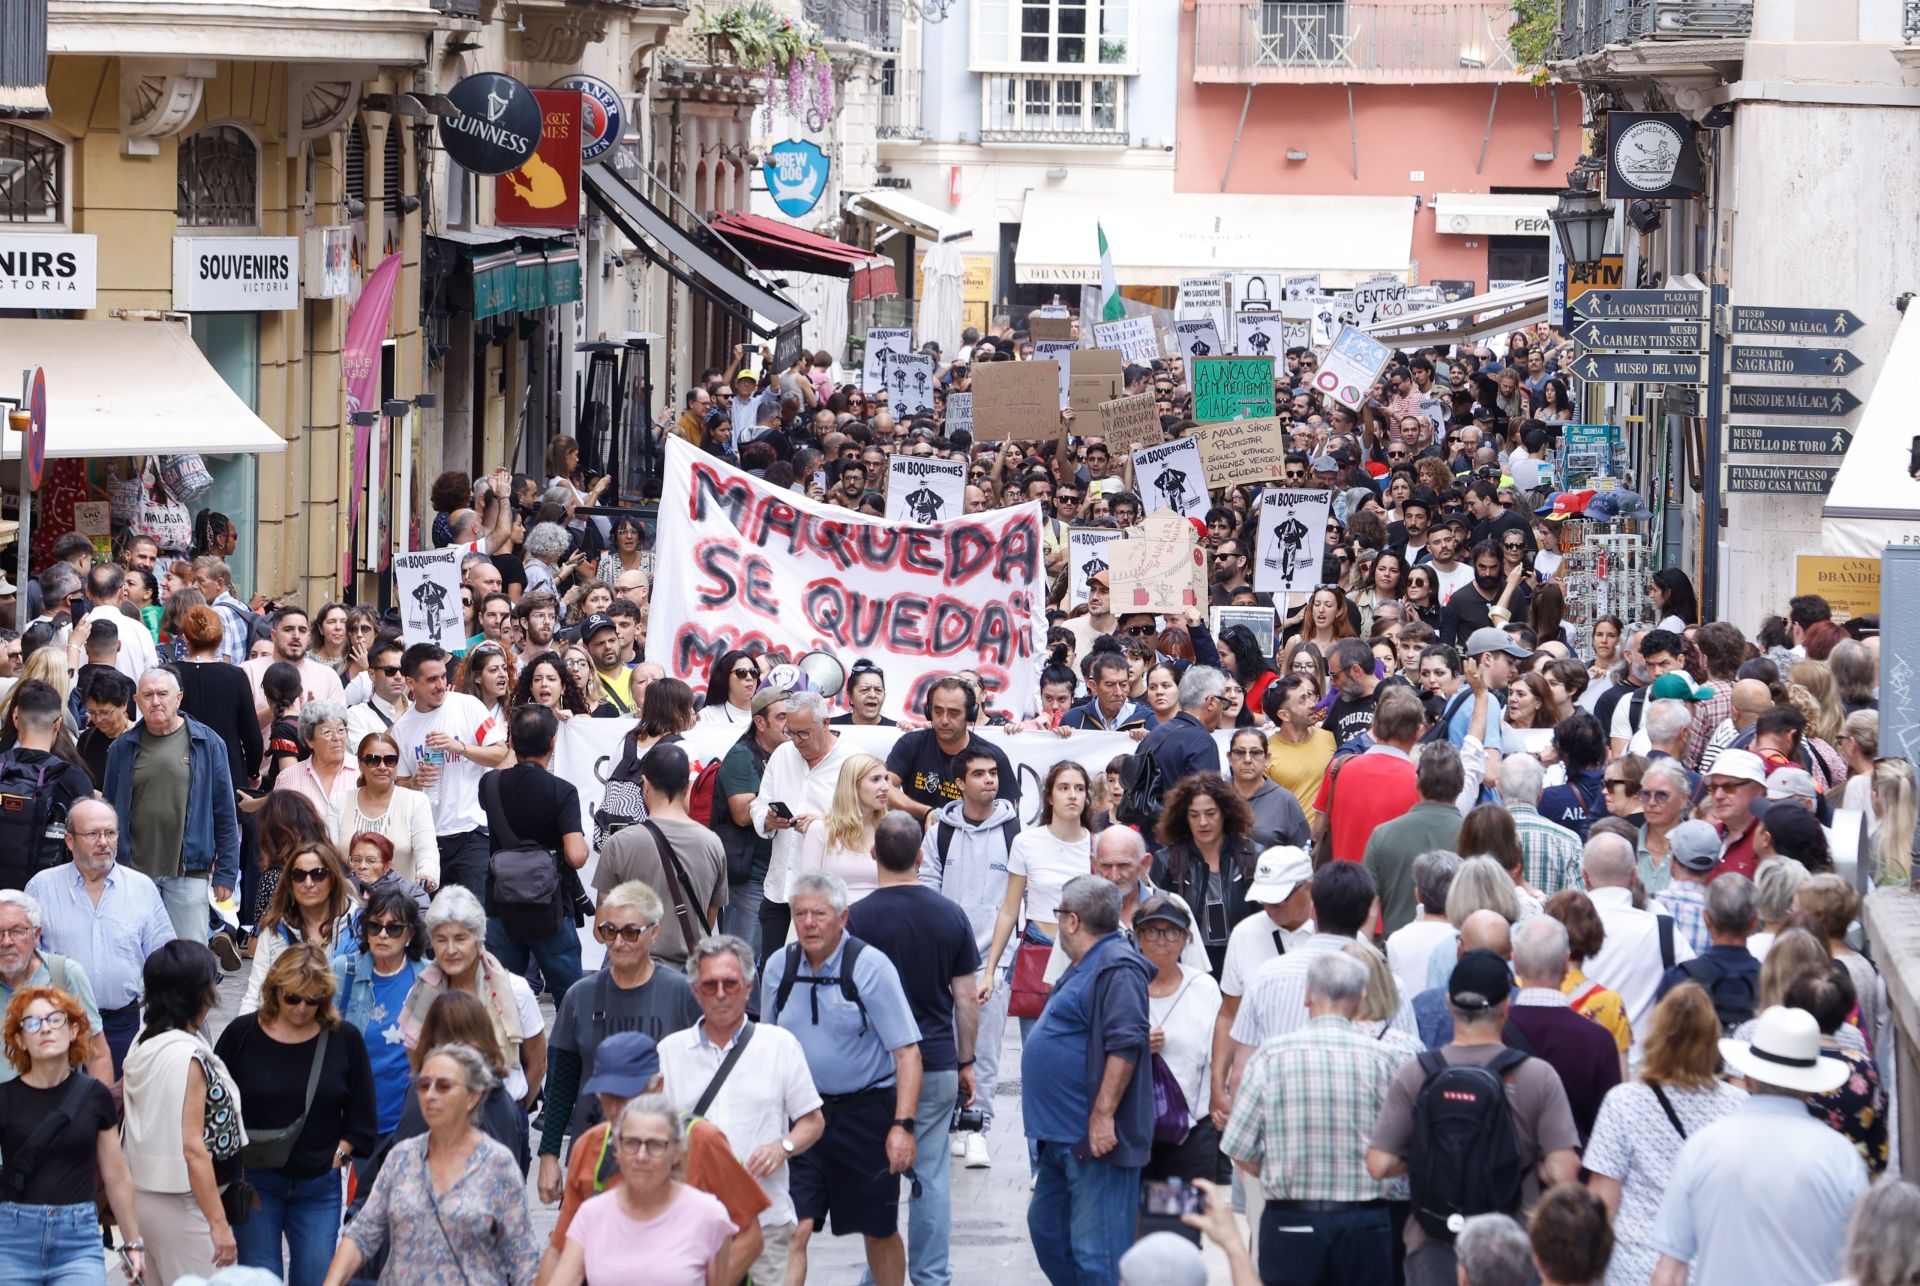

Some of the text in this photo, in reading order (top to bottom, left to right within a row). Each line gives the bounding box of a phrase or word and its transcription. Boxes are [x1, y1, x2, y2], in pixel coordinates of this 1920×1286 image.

[1631, 126, 1667, 139] MONEDAS
[775, 152, 806, 167] BREW
[780, 167, 802, 181] DOG
[200, 254, 289, 280] SOUVENIRS
[1571, 265, 1623, 284] ATM
[243, 282, 289, 292] VICTORIA
[1664, 294, 1698, 302] PLAZA DE
[1608, 301, 1697, 316] LA CONSTITUCIÓN
[1738, 309, 1765, 319] MUSEO
[1239, 314, 1280, 325] SIN BOQUERONES
[1738, 318, 1828, 334] PICASSO MÁLAGA
[869, 330, 910, 340] SIN BOQUERONES
[1185, 321, 1214, 334] BOQUERONES
[1670, 326, 1697, 335] MUSEO
[1044, 342, 1075, 353] BOQUERONES
[1603, 335, 1697, 347] CARMEN THYSSEN
[889, 354, 930, 365] SIN BOQUERONES
[1738, 348, 1785, 359] IGLESIA DEL
[1195, 361, 1209, 381] LA
[1246, 362, 1272, 381] CASA
[1615, 363, 1697, 375] MUSEO DEL VINO
[1736, 359, 1795, 373] SAGRARIO
[1194, 380, 1210, 396] QUE
[1732, 393, 1829, 409] MUSEO DE MÁLAGA
[1144, 423, 1154, 434] EN
[1191, 422, 1274, 441] DE NADA SIRVE
[1733, 428, 1763, 438] MUSEO
[1135, 437, 1196, 466] SIN BOQUERONES
[1211, 436, 1264, 452] PROTESTAR
[1733, 439, 1827, 453] REVELLO DE TORO
[1207, 447, 1275, 464] SIGUES VOTANDO
[892, 461, 963, 477] SIN BOQUERONES
[1206, 455, 1281, 472] QUIENES VENDEN
[1209, 473, 1226, 483] LA
[1228, 467, 1264, 479] CIUDAD
[1732, 466, 1828, 481] FUNDACIÓN PICASSO
[1732, 480, 1823, 492] MUSEO CASA NATAL
[1264, 491, 1329, 508] SIN BOQUERONES
[689, 461, 1040, 588] MAQUEDA
[396, 551, 456, 569] SIN BOQUERONES
[694, 536, 780, 624] SE
